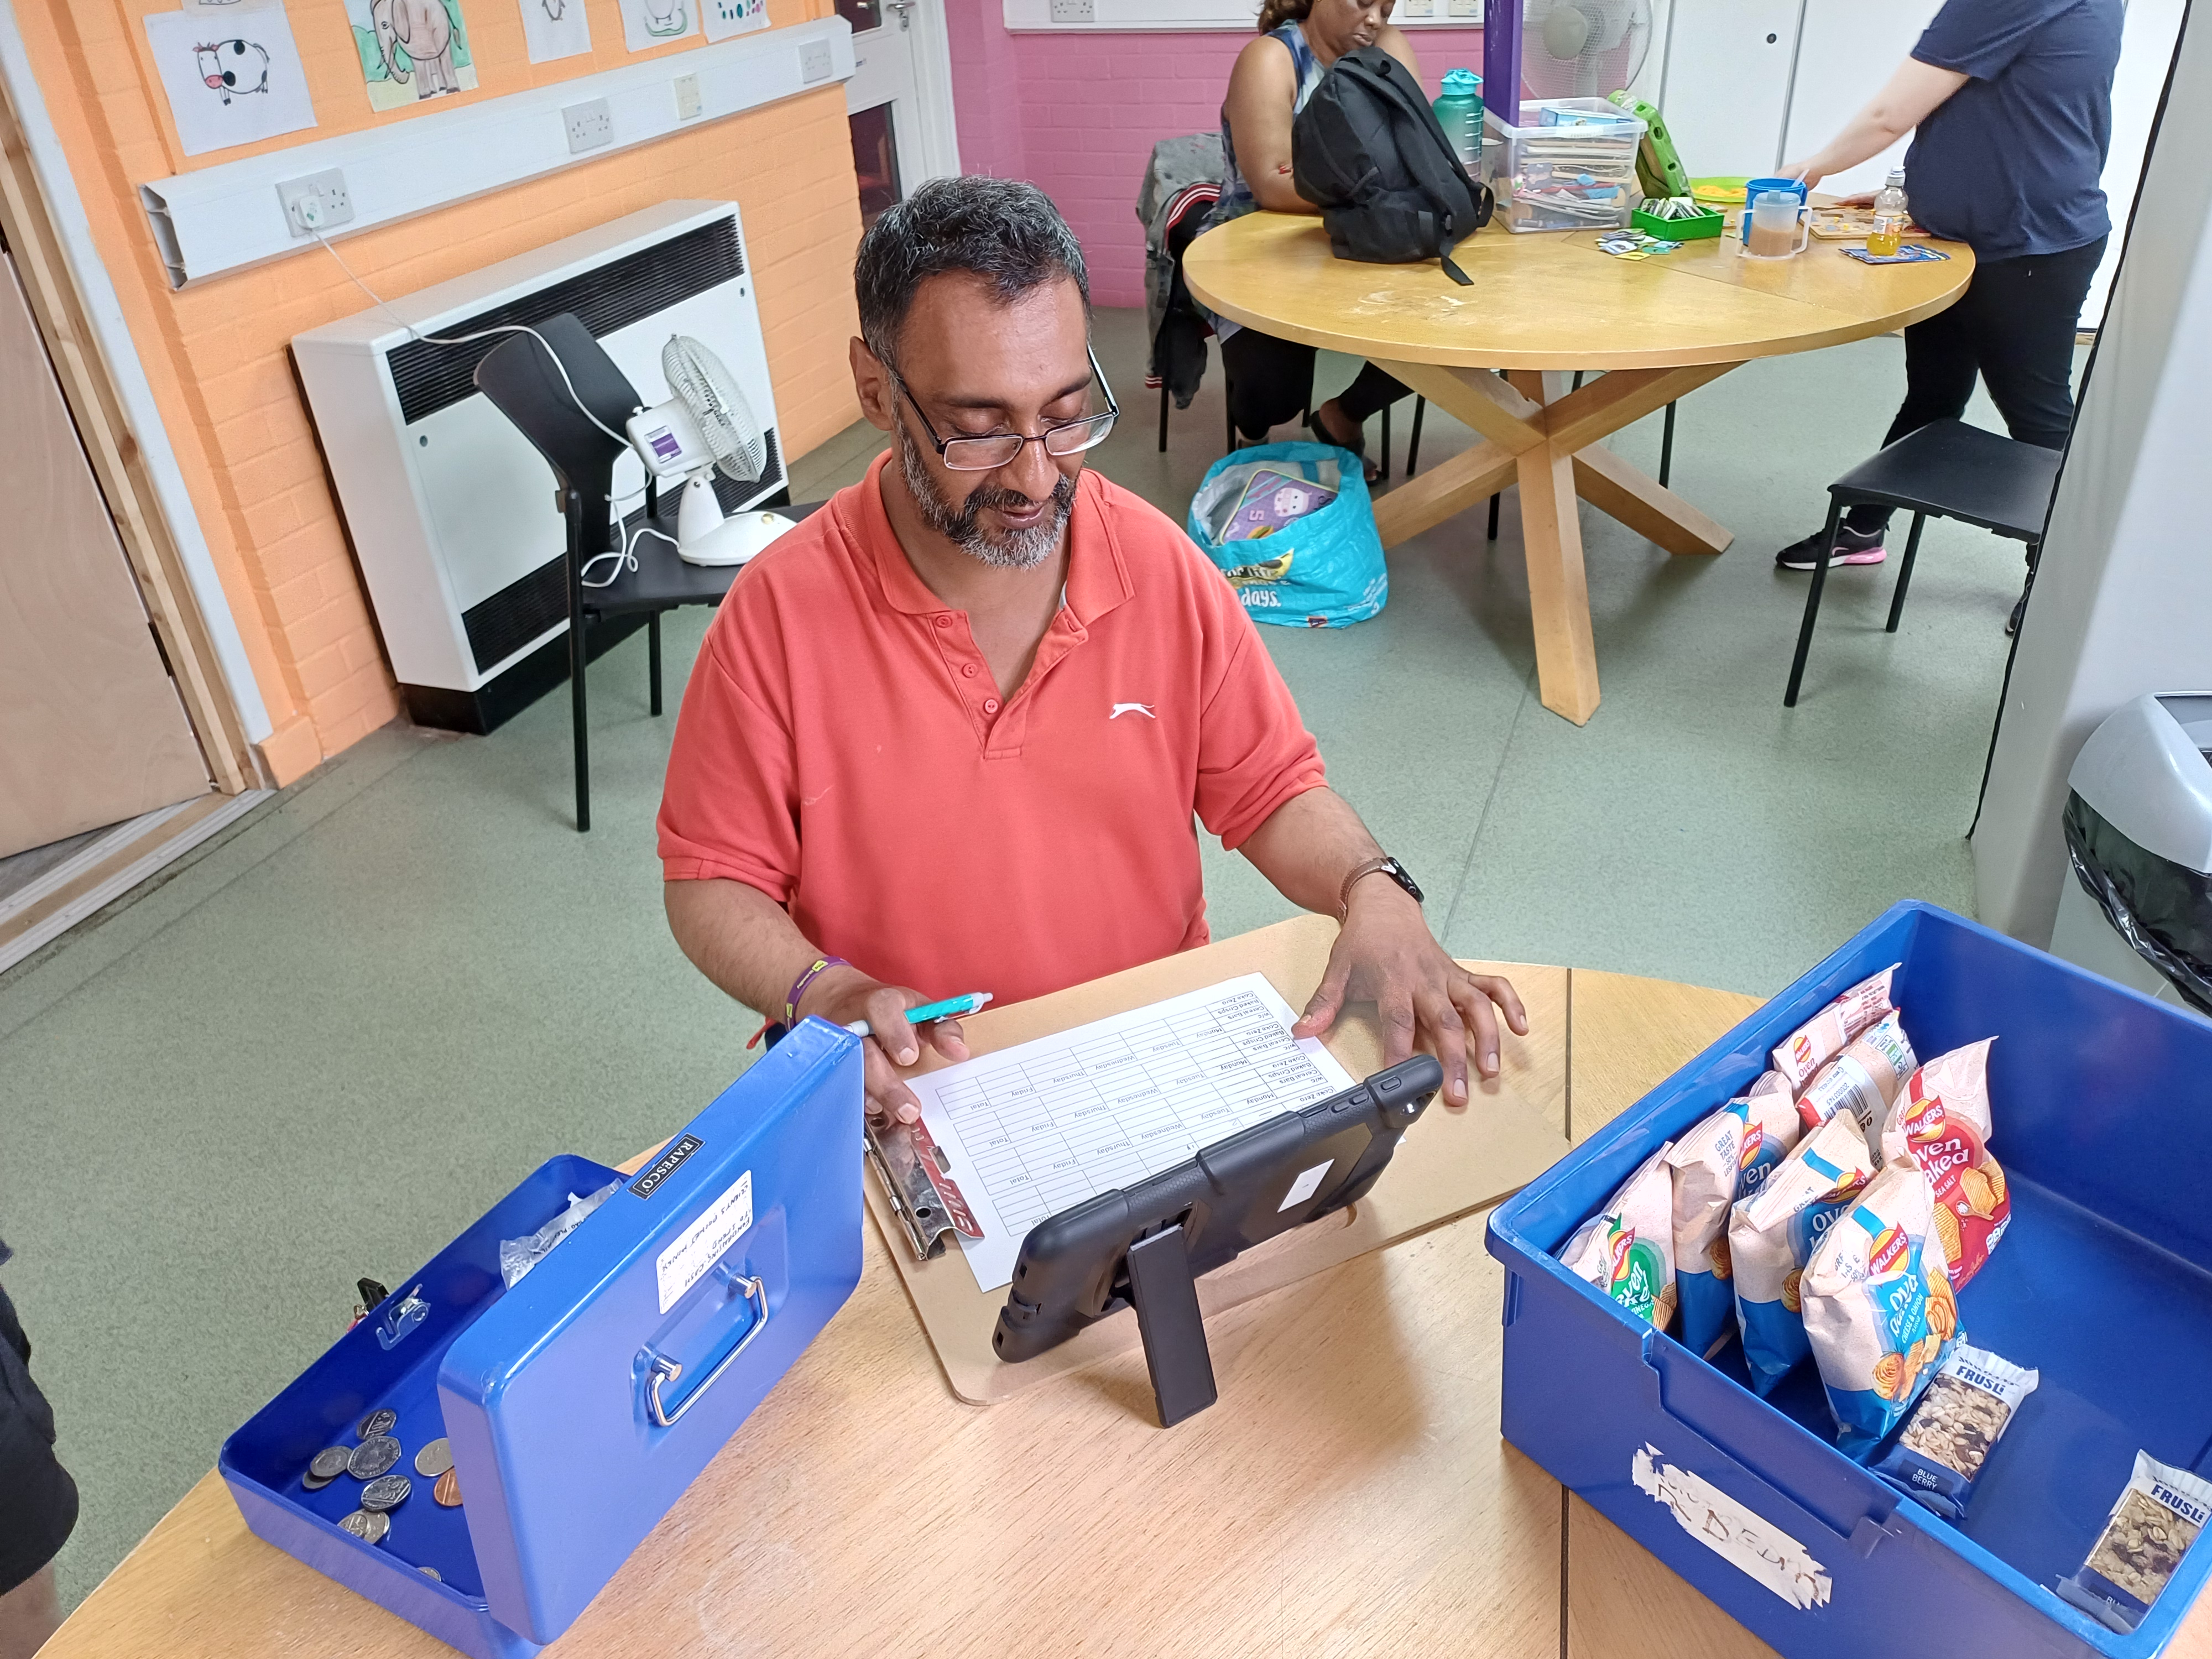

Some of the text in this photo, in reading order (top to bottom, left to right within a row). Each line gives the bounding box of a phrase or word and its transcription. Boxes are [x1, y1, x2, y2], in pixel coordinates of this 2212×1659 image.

[1241, 588, 1281, 607] days.
[1218, 999, 1259, 1014] Baked Crisps
[1243, 1006, 1264, 1015] Cereal
[1196, 1027, 1223, 1038] Monday
[1242, 1030, 1285, 1046] Baked Crisps
[1152, 1040, 1181, 1052] Tuesday
[1268, 1037, 1290, 1047] Cereal
[1796, 1040, 1810, 1061] WALKERS
[1095, 1055, 1135, 1071] Wednesday
[1220, 1059, 1248, 1071] Monday
[1268, 1062, 1312, 1078] Baked Crisps
[1798, 1057, 1815, 1078] oven
[1052, 1070, 1085, 1084] Thursday
[1176, 1072, 1204, 1085] Tuesday
[1295, 1070, 1317, 1079] Cereal
[1011, 1086, 1034, 1097] Friday
[1117, 1088, 1159, 1104] Wednesday
[1246, 1093, 1274, 1105] Monday
[969, 1101, 989, 1111] Total
[1074, 1105, 1107, 1119] Thursday
[1201, 1107, 1230, 1120] Tuesday
[1031, 1121, 1054, 1133] Friday
[1905, 1104, 1944, 1135] WALKERS
[1140, 1123, 1183, 1139] Wednesday
[989, 1136, 1009, 1147] Total
[1096, 1140, 1130, 1155] Thursday
[1715, 1130, 1733, 1152] GREAT
[1741, 1130, 1761, 1152] KERS
[1720, 1140, 1735, 1161] TASTE
[641, 1141, 693, 1189] RAPESCO
[1052, 1159, 1076, 1170] Friday
[1924, 1149, 1969, 1187] aked
[1009, 1174, 1030, 1185] Total
[1741, 1162, 1771, 1191] ven
[1936, 1175, 1957, 1198] SEA SALT
[1812, 1204, 1849, 1232] ov
[712, 1223, 735, 1250] SPEND
[1612, 1235, 1632, 1272] LKERS
[1870, 1232, 1907, 1276] WALKERS
[685, 1264, 704, 1287] CASH
[1902, 1317, 1913, 1344] CHEESE
[1911, 1292, 1924, 1316] ONION
[1912, 1473, 1938, 1490] BERRY
[1917, 1468, 1938, 1483] BLUE
